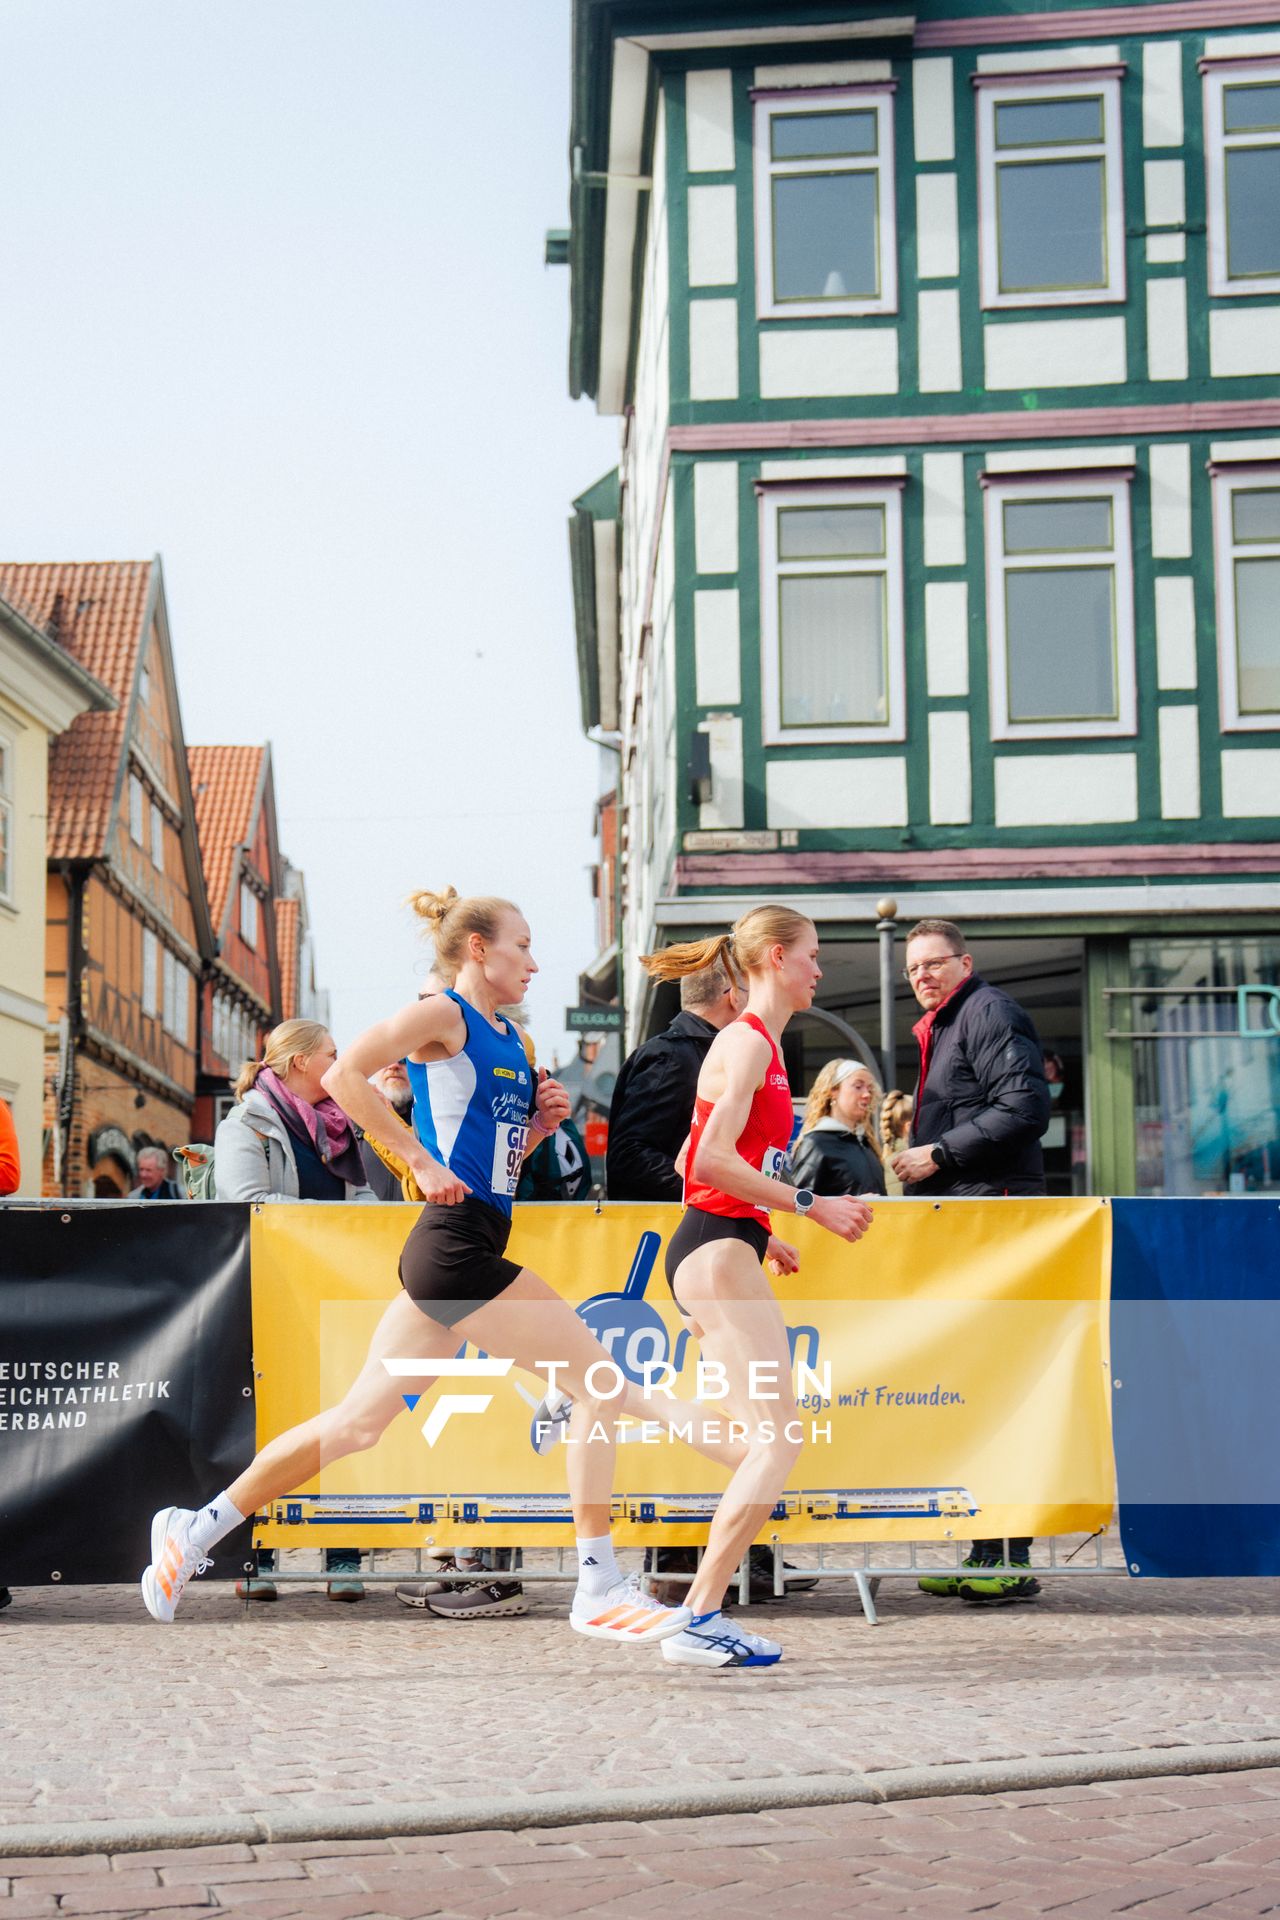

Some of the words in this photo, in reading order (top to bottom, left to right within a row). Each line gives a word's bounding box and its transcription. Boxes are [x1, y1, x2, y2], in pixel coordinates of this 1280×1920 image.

[507, 1126, 530, 1151] GL
[506, 1149, 524, 1178] 92
[0, 1362, 120, 1380] EUTSCHER
[0, 1381, 170, 1405] EICHTATHLETIK
[838, 1387, 870, 1407] mit
[875, 1384, 966, 1407] Freunden.
[0, 1411, 87, 1431] ERBAND
